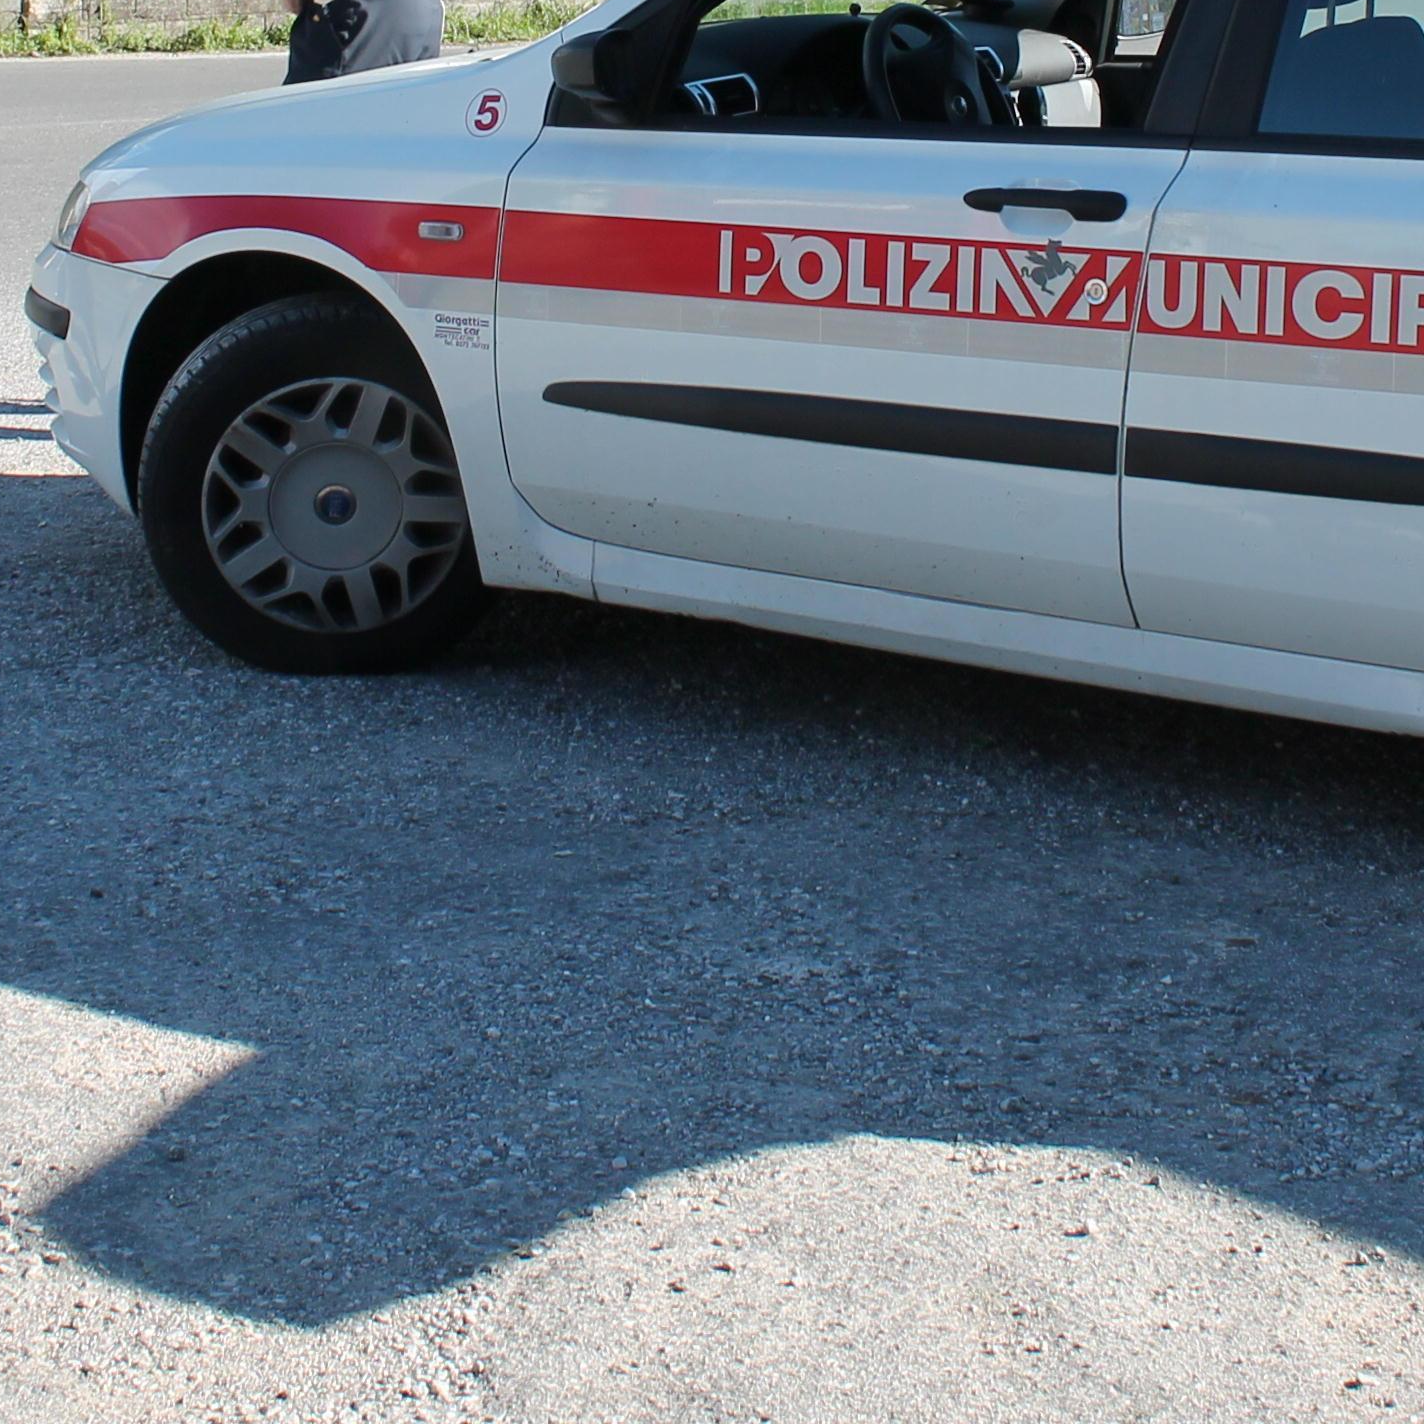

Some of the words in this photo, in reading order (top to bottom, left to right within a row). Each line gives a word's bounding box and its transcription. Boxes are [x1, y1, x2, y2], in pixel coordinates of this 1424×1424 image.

[474, 95, 501, 131] 5
[718, 229, 1037, 319] POLIZIA
[463, 327, 480, 336] car
